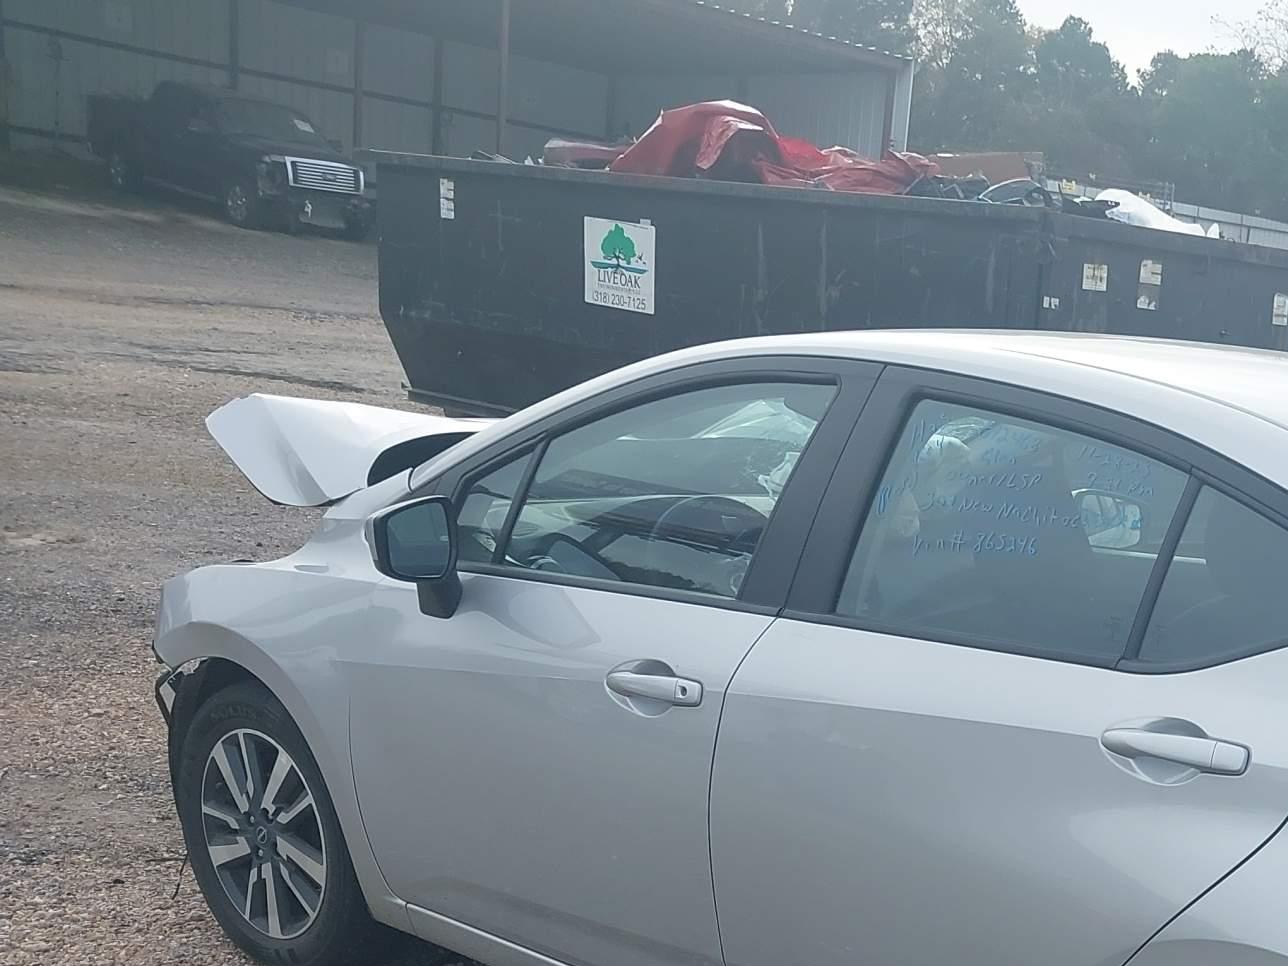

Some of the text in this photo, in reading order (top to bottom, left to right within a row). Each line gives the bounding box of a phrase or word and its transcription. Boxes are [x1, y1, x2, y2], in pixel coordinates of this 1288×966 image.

[597, 270, 641, 289] LIVE OAK
[593, 291, 647, 310] (318) 230-7125
